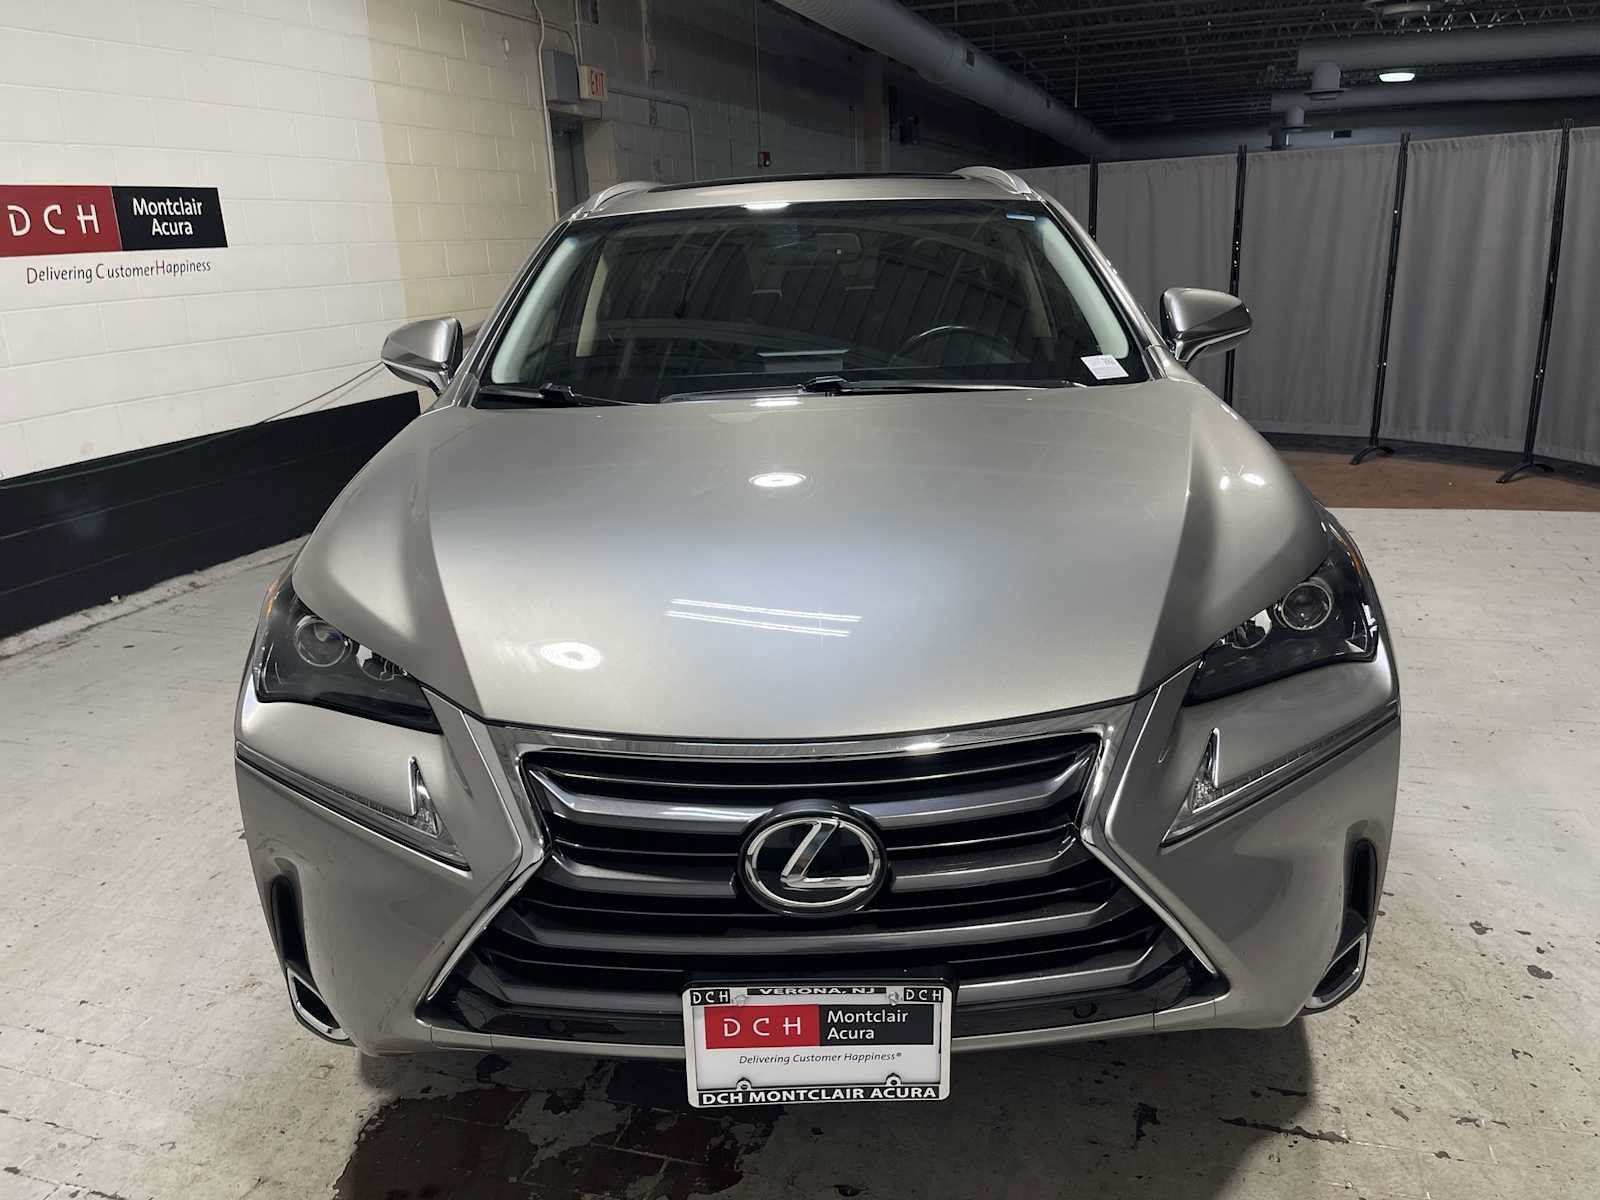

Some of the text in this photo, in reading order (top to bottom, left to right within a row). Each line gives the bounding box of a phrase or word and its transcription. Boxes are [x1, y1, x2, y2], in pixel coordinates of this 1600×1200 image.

[132, 197, 203, 216] Montclair
[151, 218, 193, 236] Acura
[26, 266, 93, 284] Delivering
[692, 990, 729, 1004] DCH
[905, 989, 942, 1001] DCH
[827, 1009, 909, 1023] Montclair
[827, 1027, 875, 1040] Acura
[739, 1055, 790, 1065] Delivering
[792, 1054, 841, 1063] Customer
[702, 1087, 936, 1105] DCH MONTCLAIR ACURA
